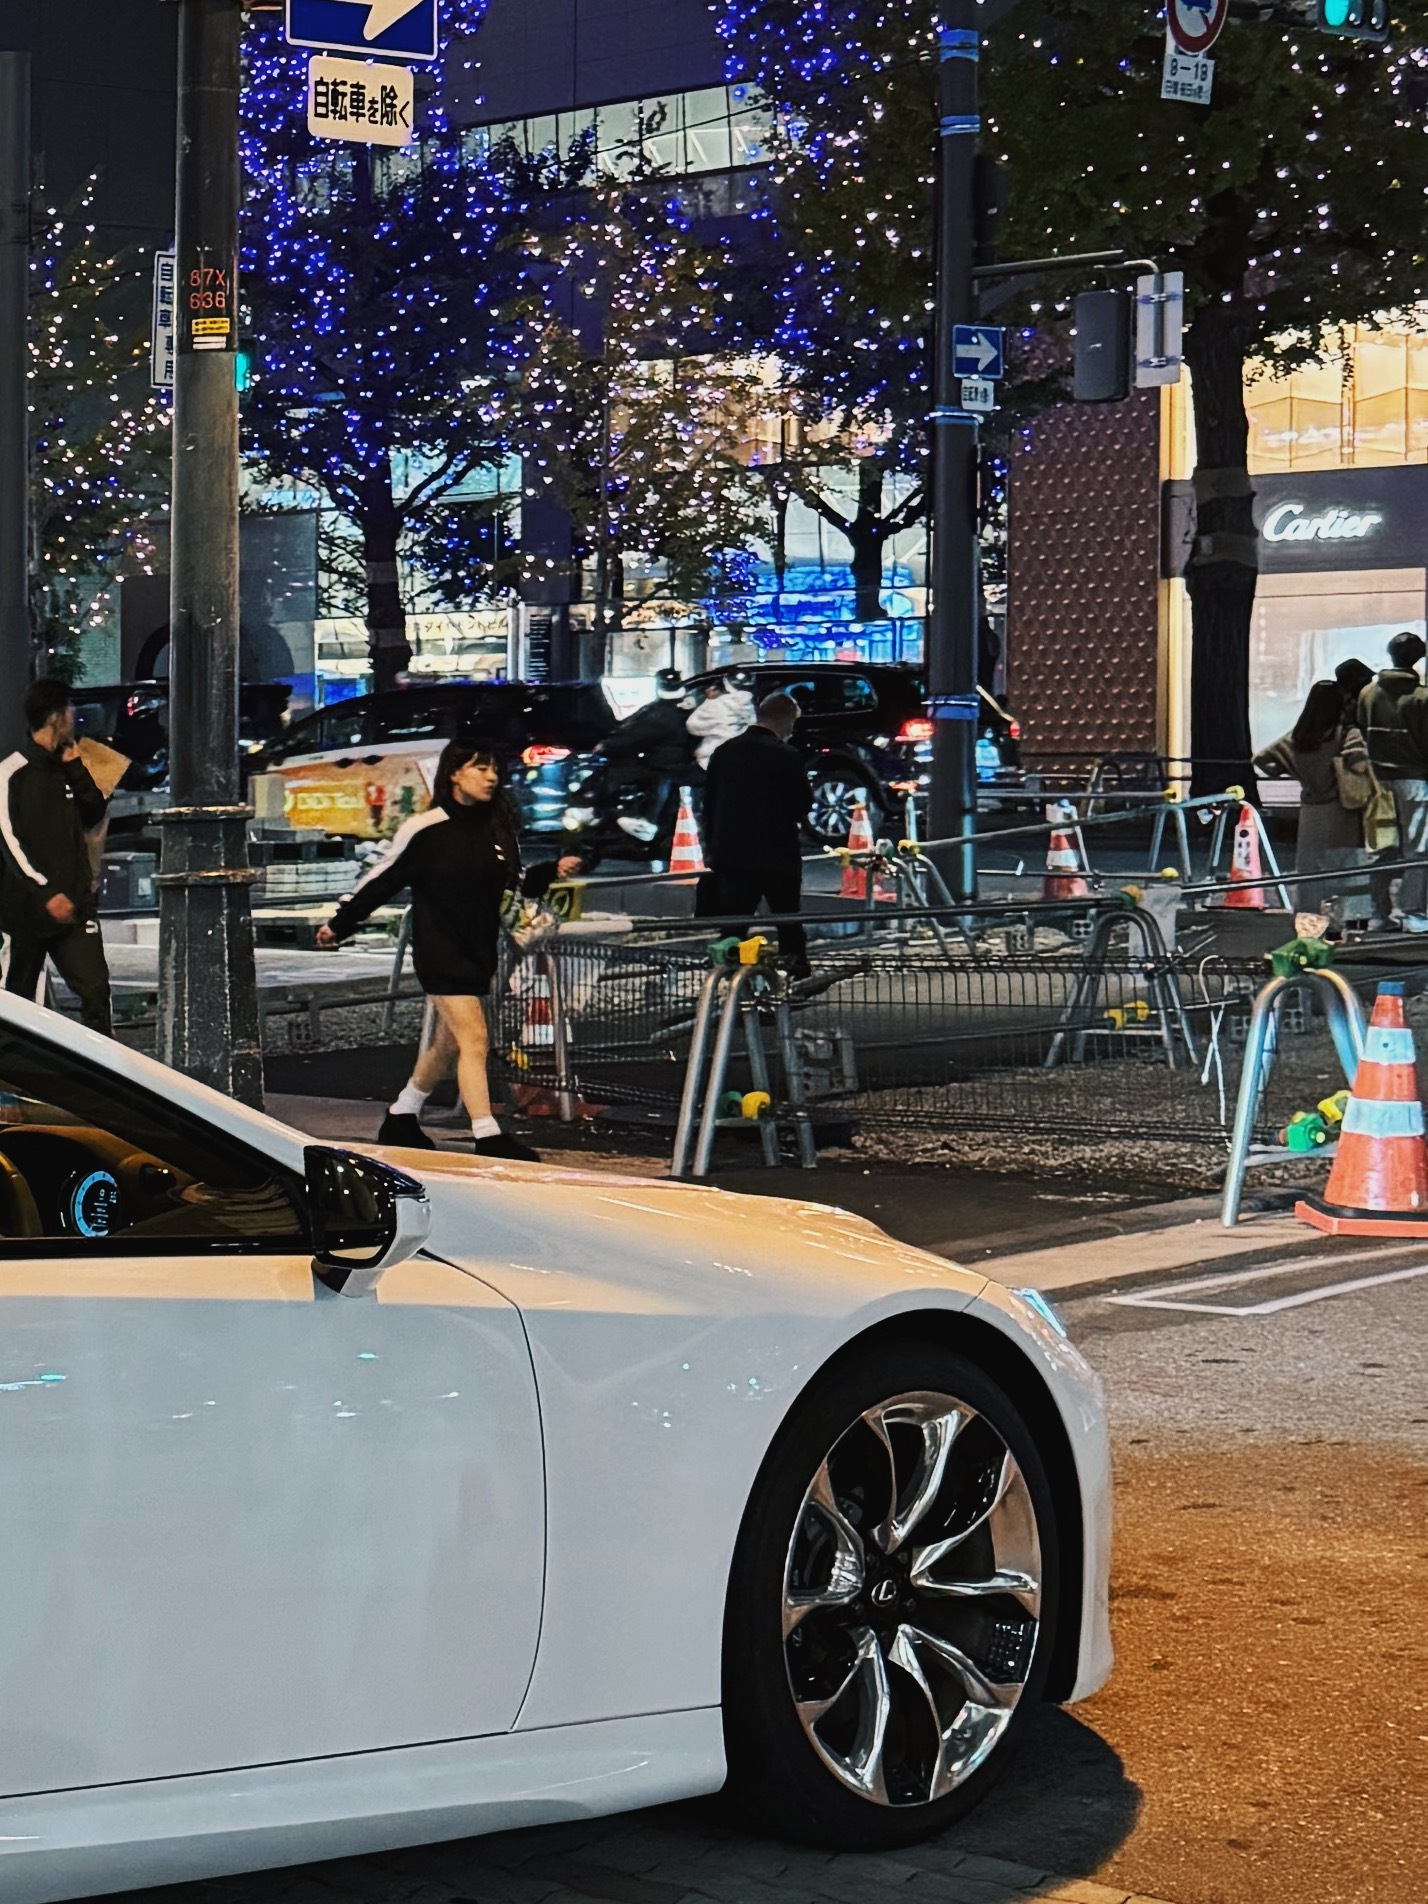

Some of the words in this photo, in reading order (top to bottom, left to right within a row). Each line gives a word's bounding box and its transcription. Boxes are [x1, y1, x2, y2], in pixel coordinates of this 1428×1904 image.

[313, 76, 410, 129] 自転車を除く
[1262, 503, 1383, 543] Cartier
